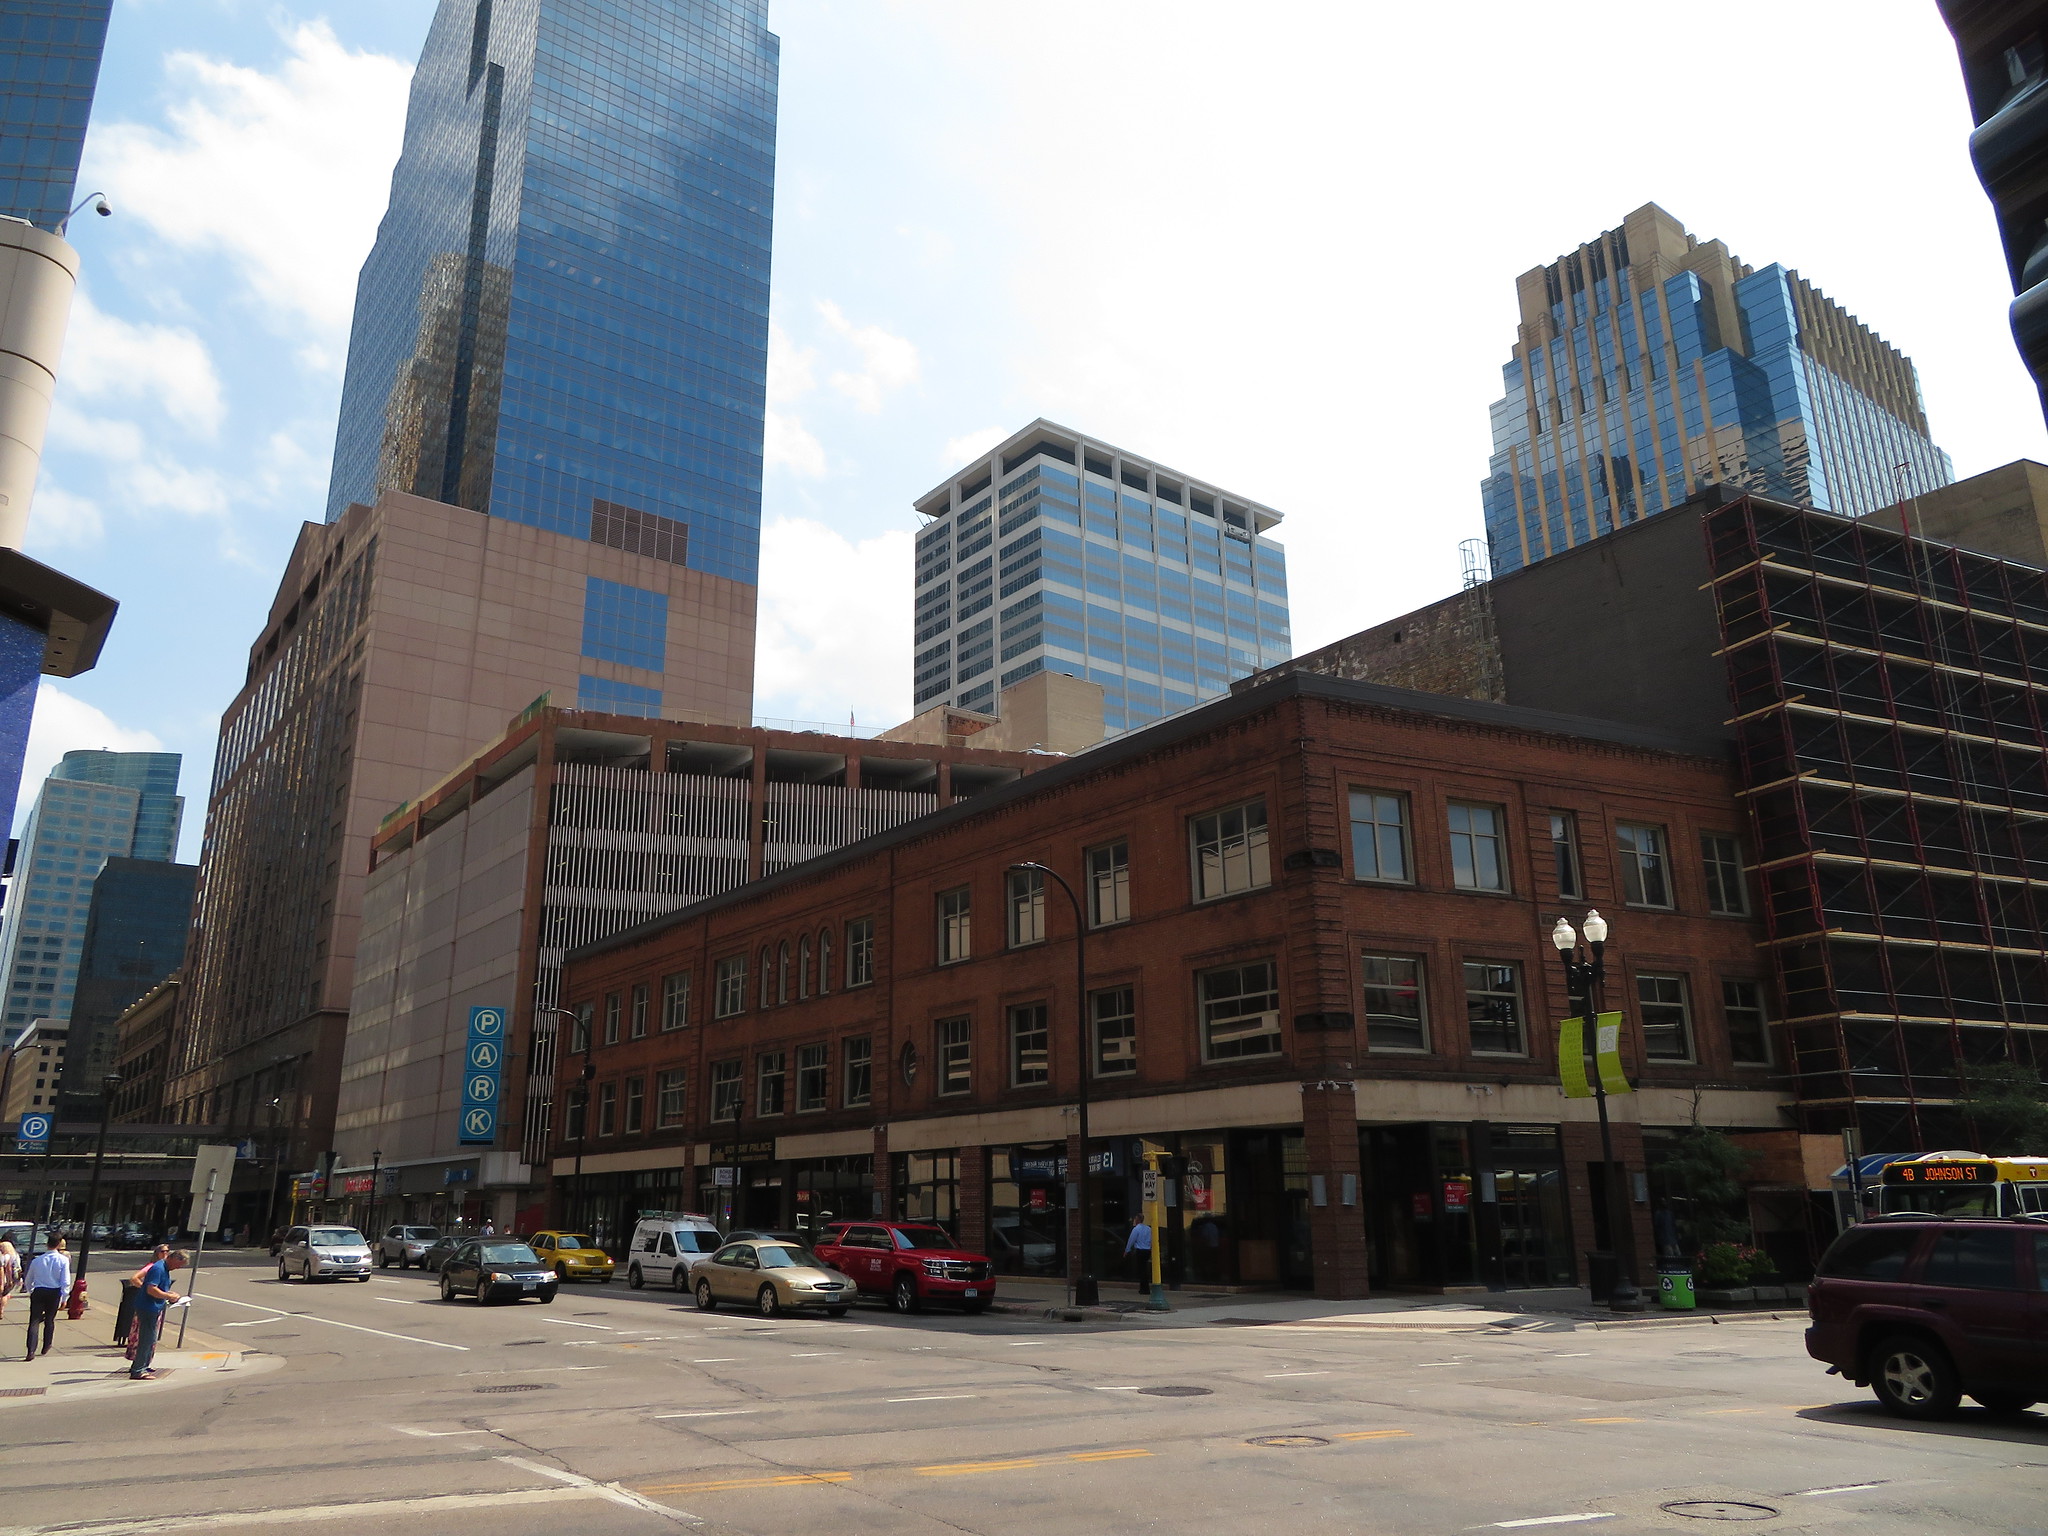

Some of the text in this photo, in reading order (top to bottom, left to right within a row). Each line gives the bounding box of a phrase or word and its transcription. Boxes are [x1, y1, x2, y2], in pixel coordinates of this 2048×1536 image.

[471, 1013, 496, 1131] PARK
[749, 1142, 772, 1152] PALACE
[1144, 1172, 1156, 1181] ONE
[1902, 1166, 1977, 1181] 4B JOHNSON ST
[1144, 1181, 1155, 1189] WAY
